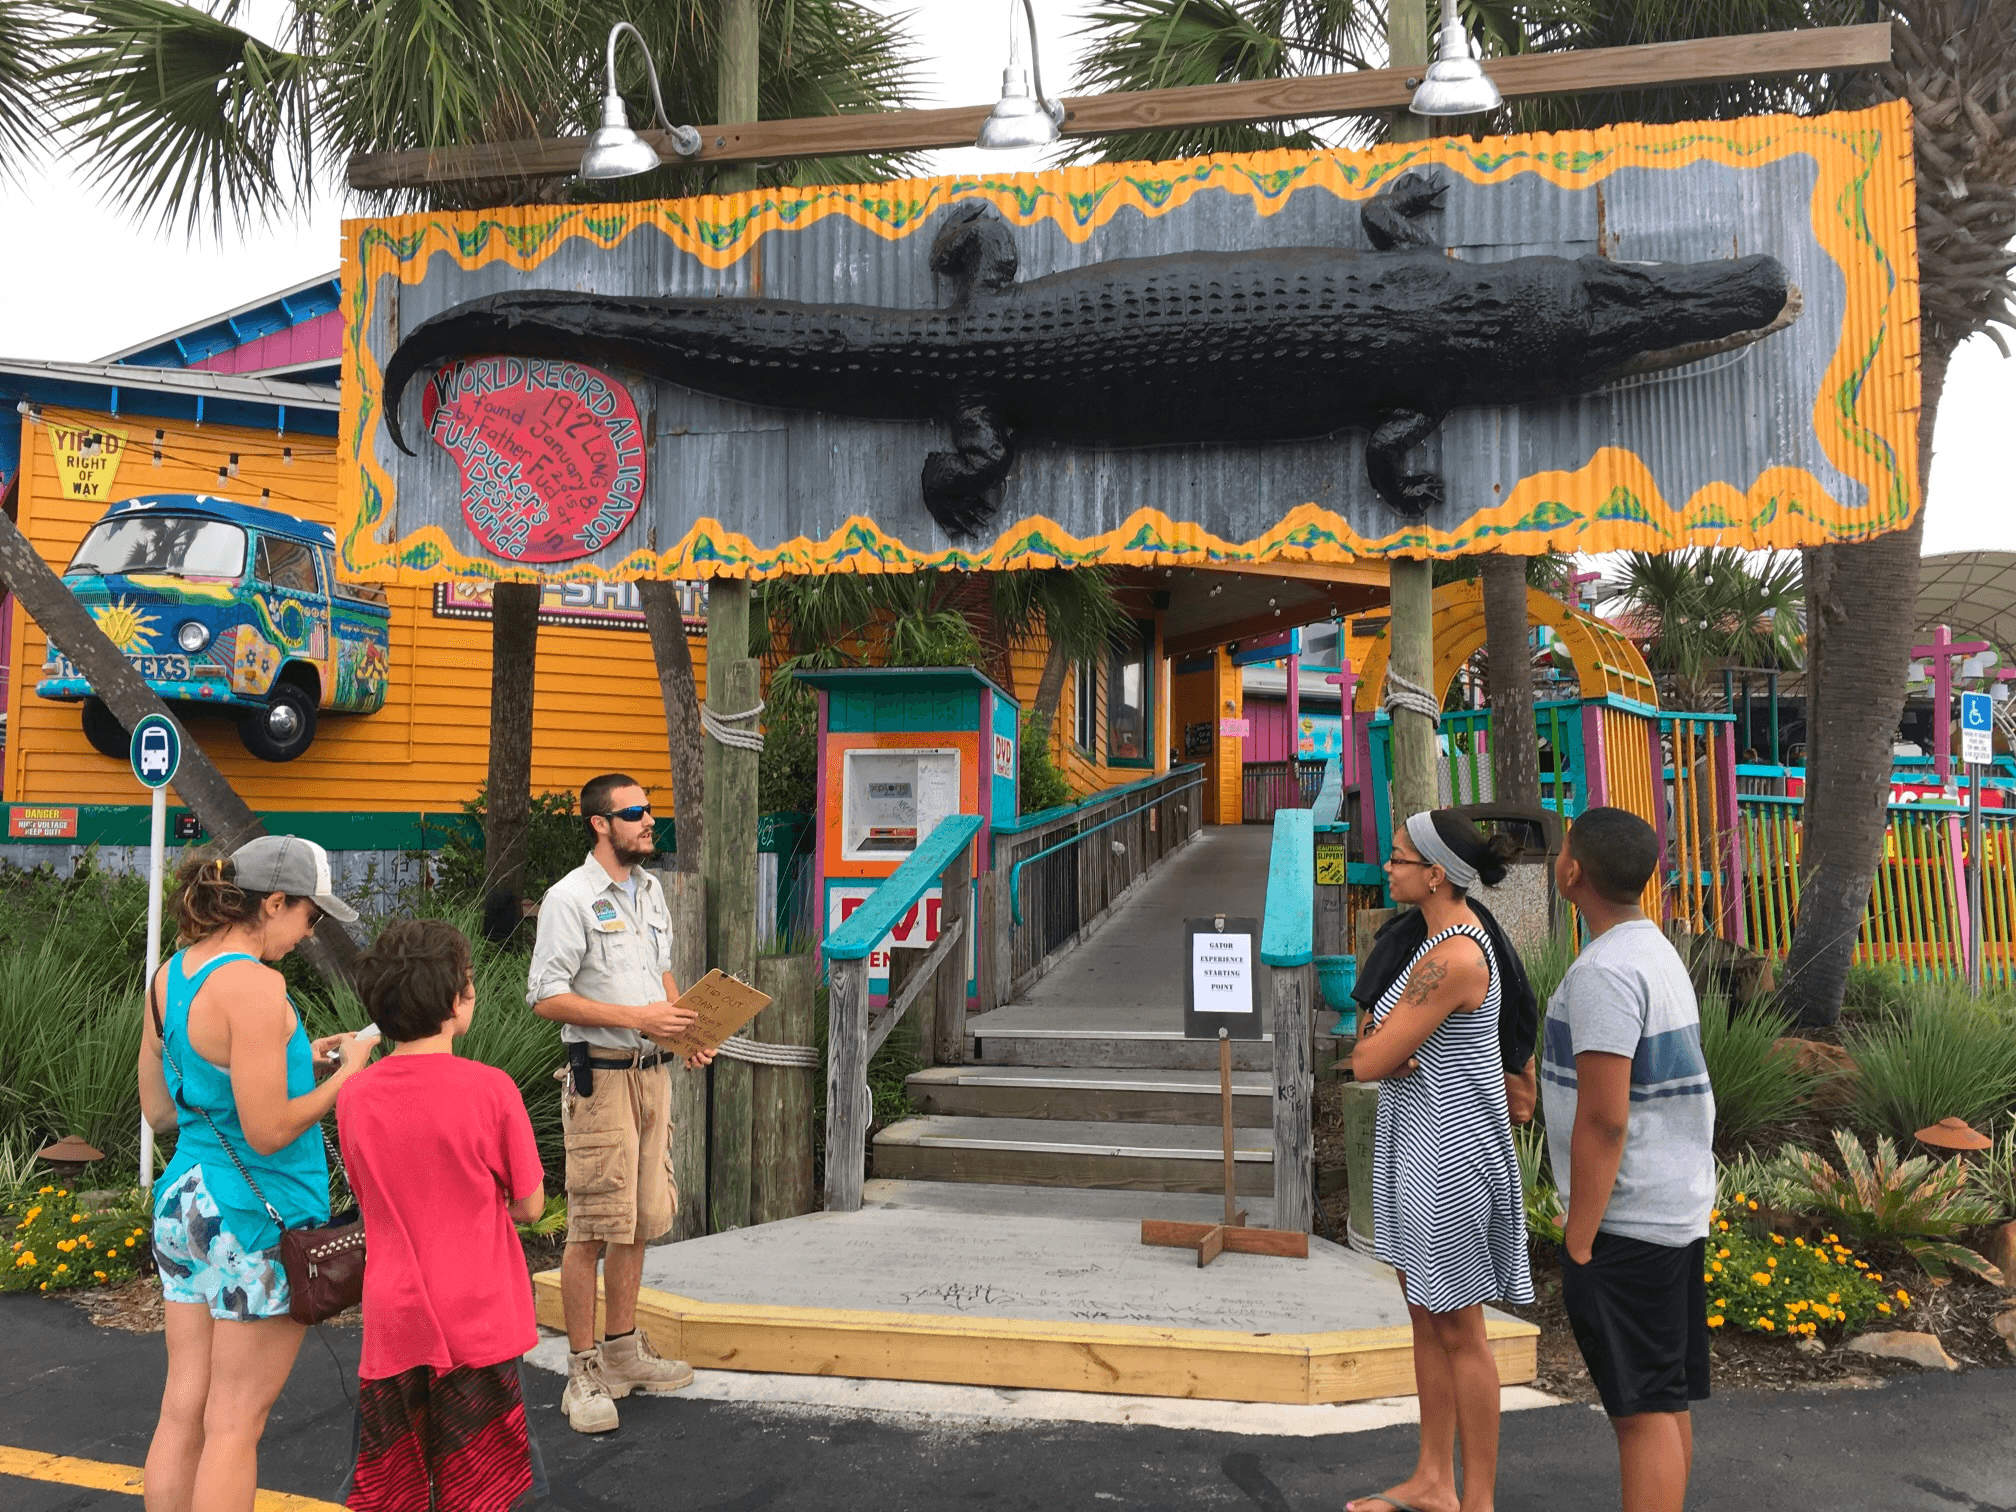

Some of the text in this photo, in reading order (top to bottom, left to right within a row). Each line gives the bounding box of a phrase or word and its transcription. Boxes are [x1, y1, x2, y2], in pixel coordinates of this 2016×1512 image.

[54, 429, 119, 455] YIED
[473, 394, 526, 426] found
[530, 420, 588, 492] January
[432, 358, 642, 551] WORLD RECORD ALLIGATOR
[455, 405, 561, 500] by Father Fud
[66, 455, 108, 471] RIGHT
[581, 434, 608, 488] LONG
[78, 470, 95, 482] OF
[72, 481, 99, 496] WAY
[462, 484, 526, 559] Florida
[996, 735, 1012, 764] DVD
[25, 809, 60, 819] DANGER
[37, 821, 68, 829] VOLTAGE
[1317, 852, 1344, 860] SLIPPERY
[1209, 942, 1233, 950] GATOR
[1200, 955, 1244, 963] EXPERIENCE
[1204, 969, 1241, 977] STARTING
[1211, 983, 1234, 991] POINT
[721, 996, 744, 1009] OUT
